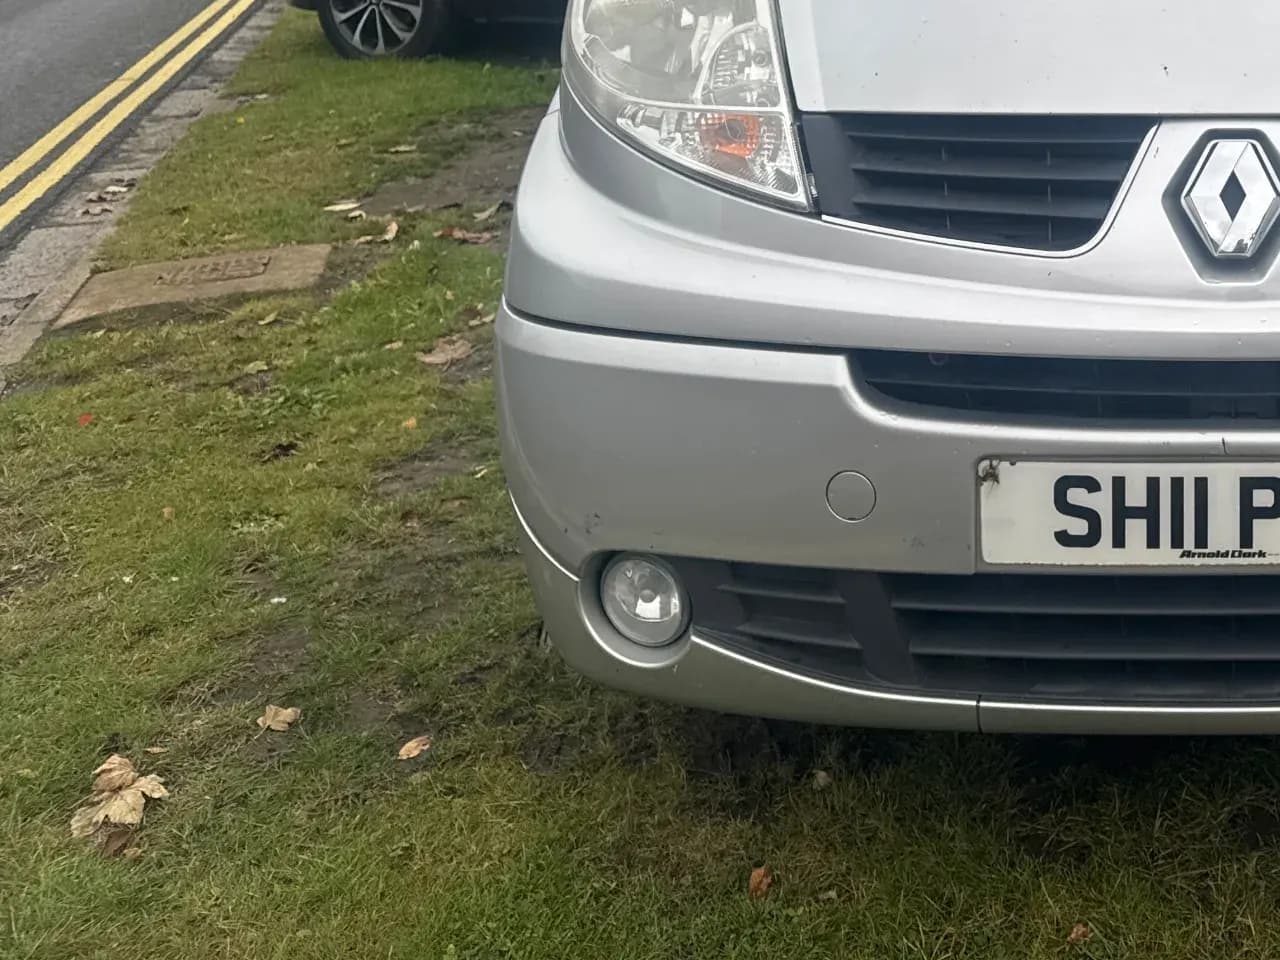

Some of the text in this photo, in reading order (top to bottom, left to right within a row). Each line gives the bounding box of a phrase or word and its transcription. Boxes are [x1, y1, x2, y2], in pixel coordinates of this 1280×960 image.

[1053, 474, 1209, 549] SH11
[1179, 549, 1230, 559] Arnold
[1231, 549, 1267, 559] Clark
